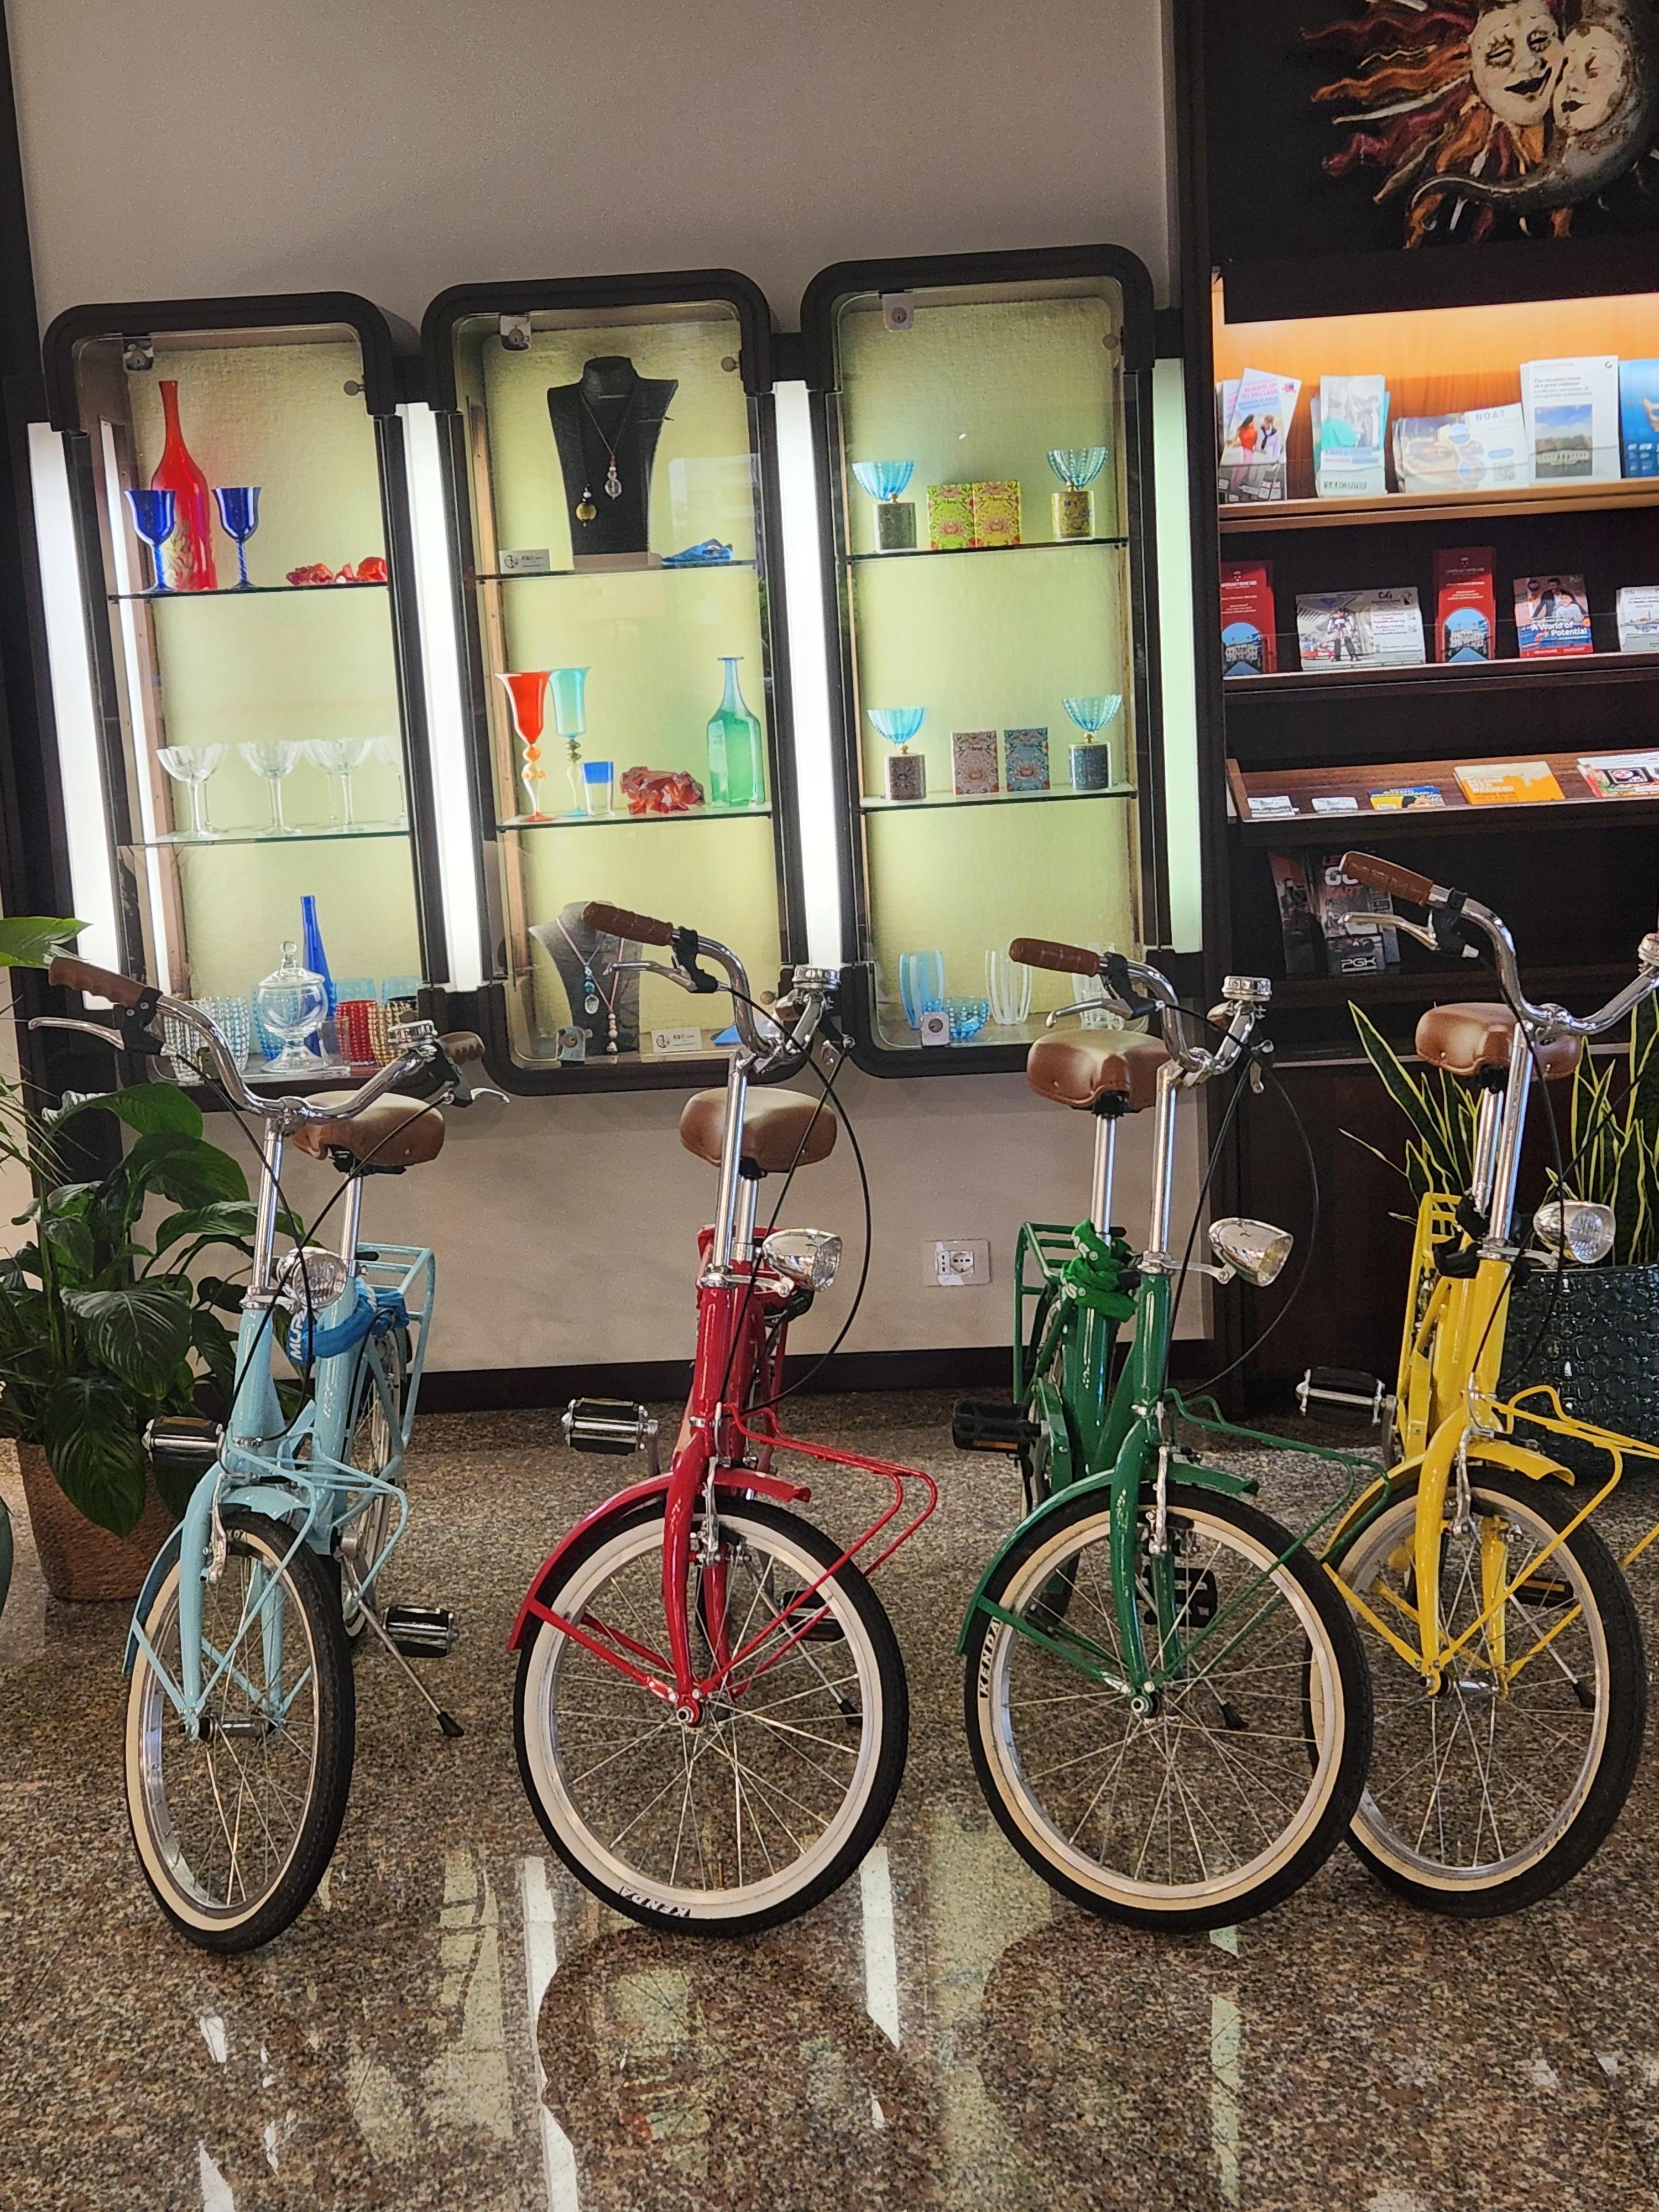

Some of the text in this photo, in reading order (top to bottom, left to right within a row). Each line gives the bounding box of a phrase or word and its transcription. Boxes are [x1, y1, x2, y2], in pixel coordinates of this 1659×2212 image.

[1475, 410, 1505, 421] BOAT
[1531, 620, 1574, 632] A World of
[1551, 627, 1588, 637] Potential
[1340, 956, 1377, 969] PGK
[979, 1619, 1001, 1698] KENDA
[619, 1885, 691, 1918] KENDA
